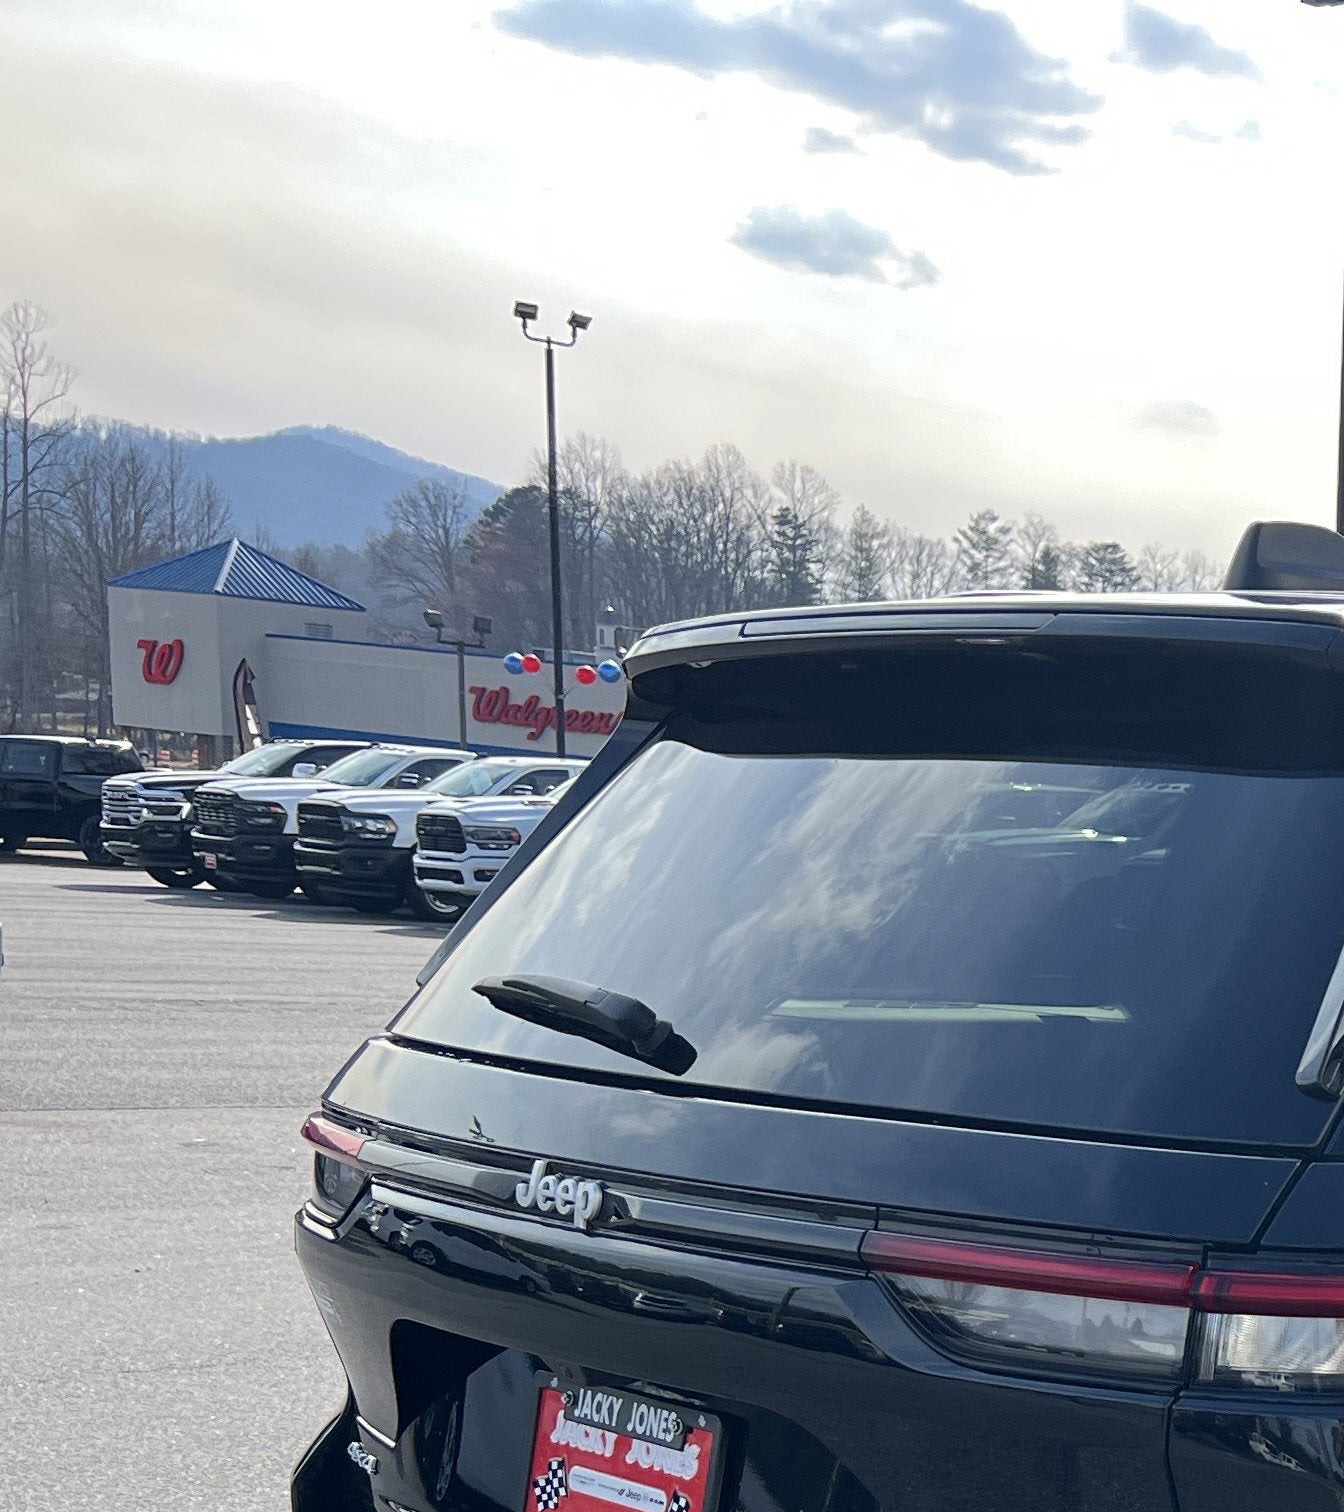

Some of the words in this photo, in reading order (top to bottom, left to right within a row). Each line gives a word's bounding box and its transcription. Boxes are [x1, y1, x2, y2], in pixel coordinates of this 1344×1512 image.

[137, 639, 184, 685] W
[515, 1159, 603, 1230] Jeep
[574, 1388, 623, 1427] JACKY
[628, 1402, 677, 1442] JONES
